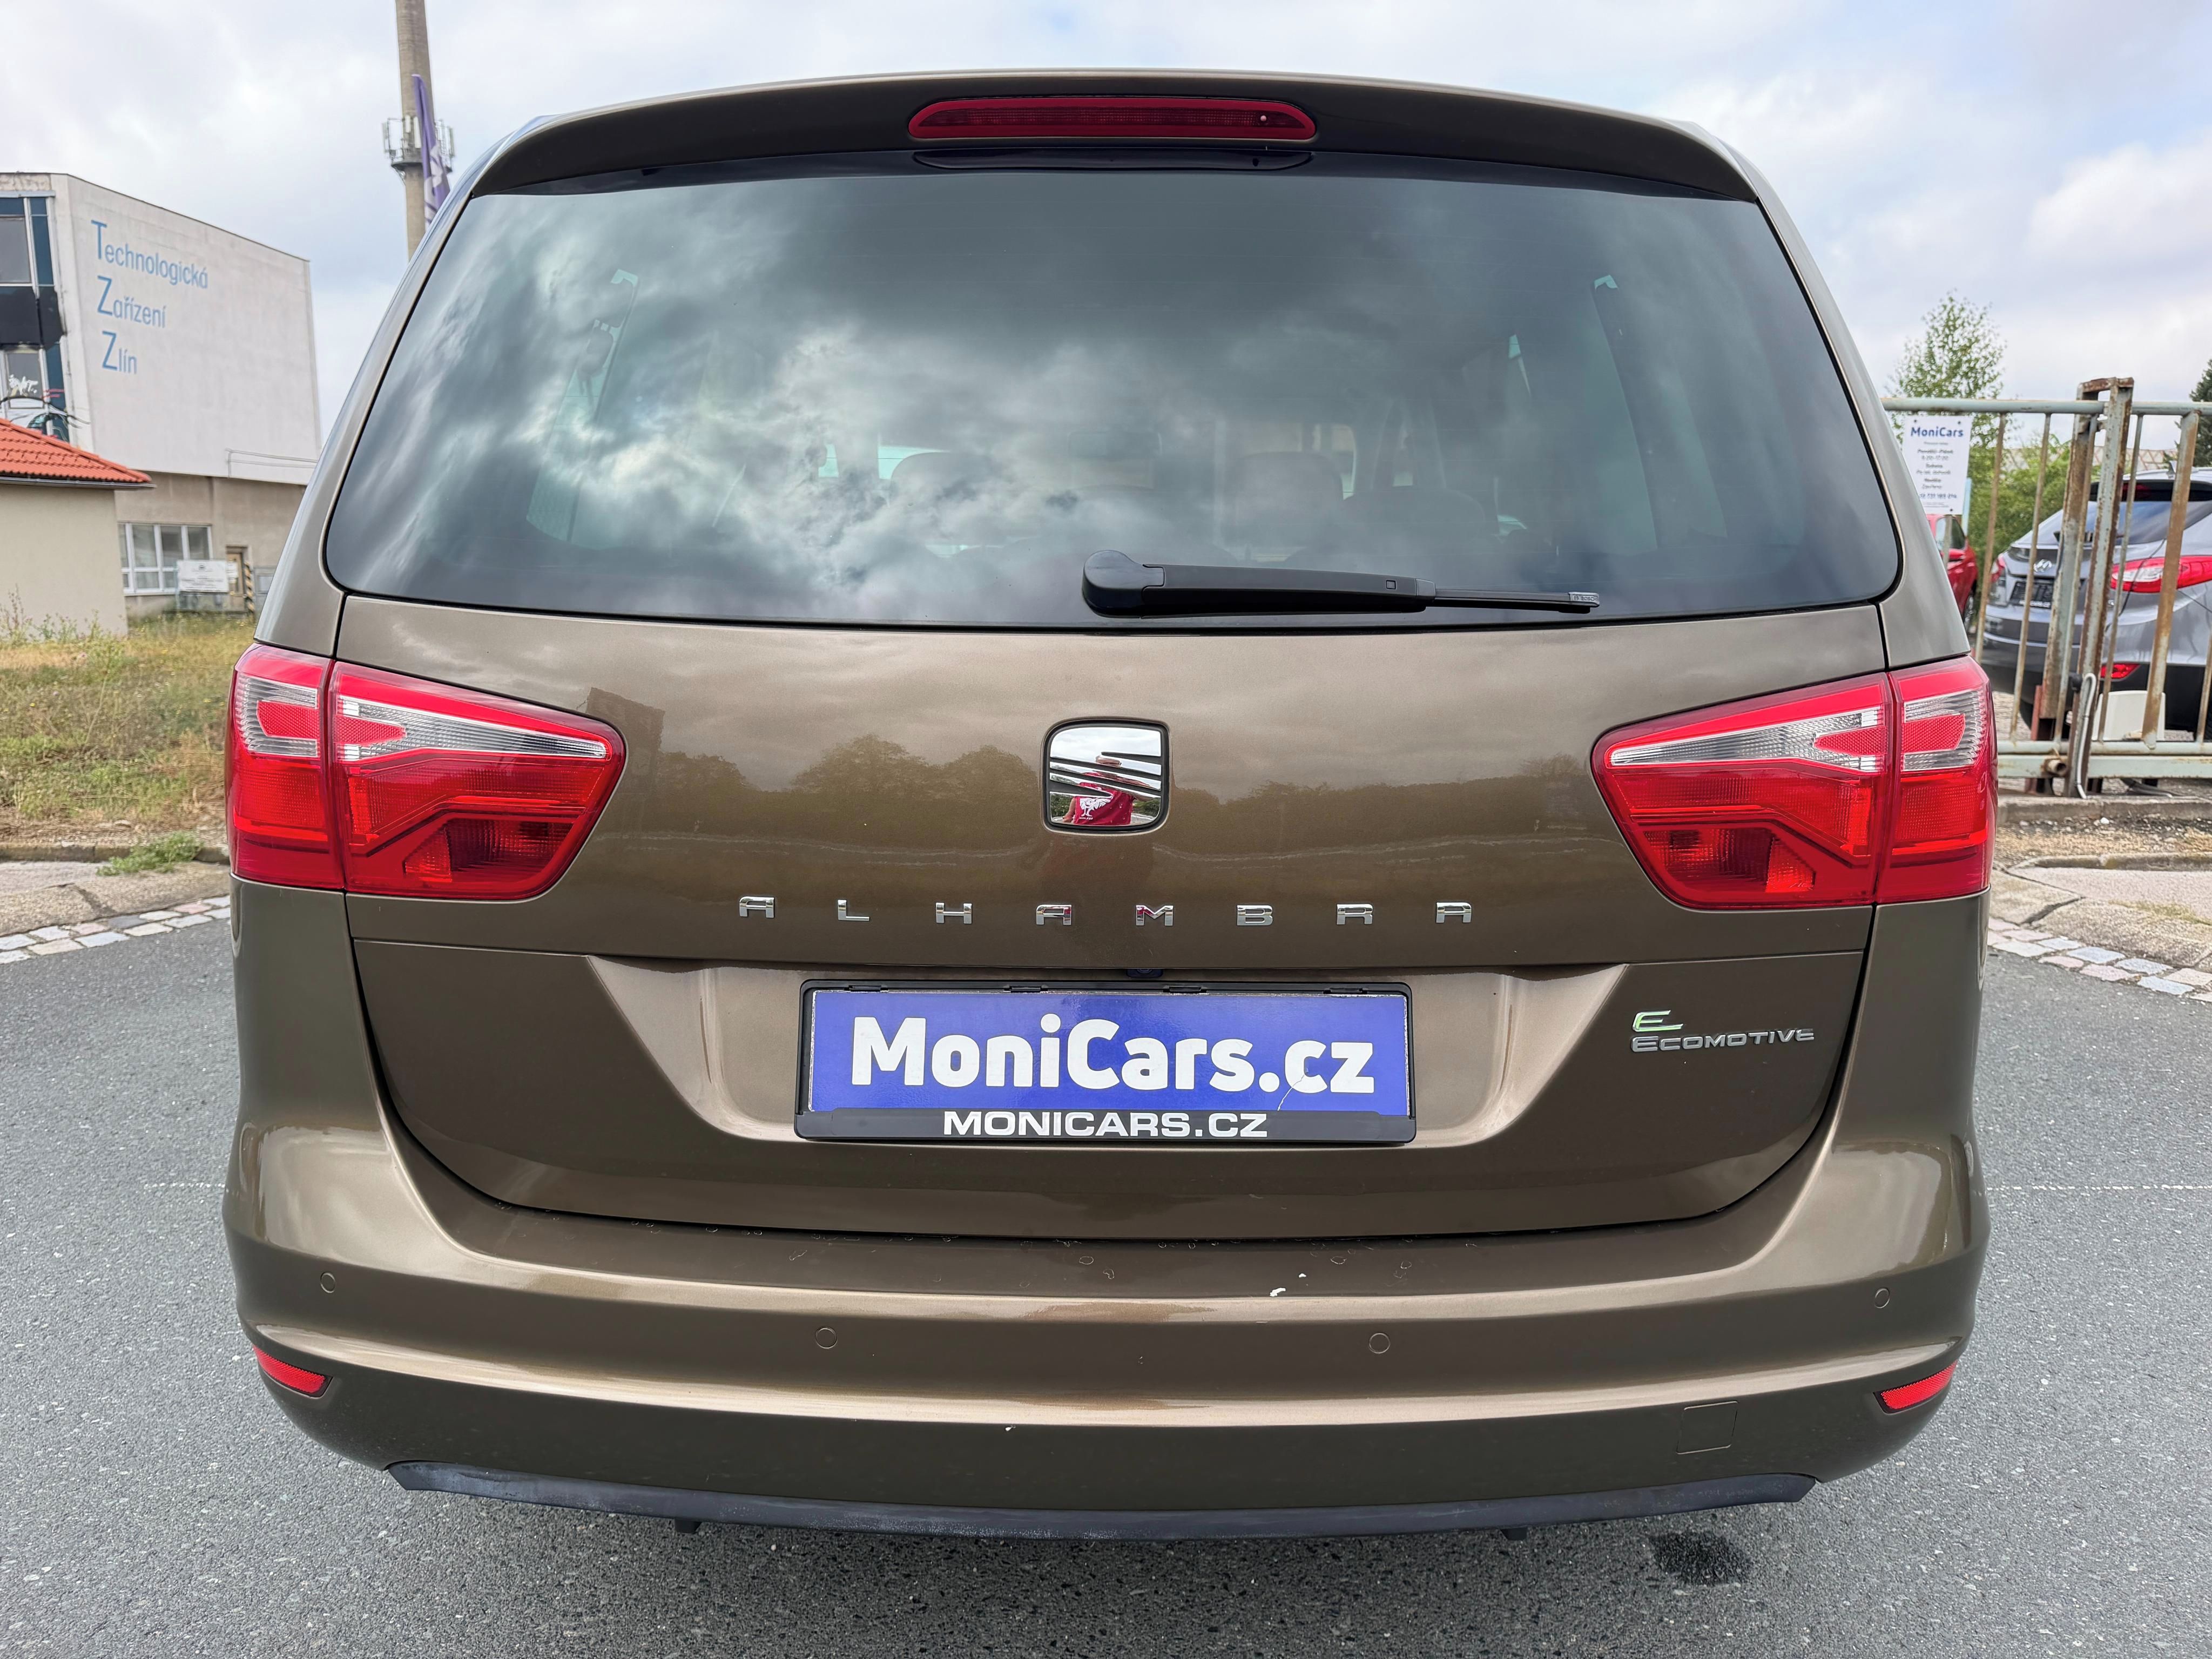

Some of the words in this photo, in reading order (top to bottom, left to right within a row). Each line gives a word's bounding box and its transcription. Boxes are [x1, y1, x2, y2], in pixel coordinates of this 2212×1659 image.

[91, 220, 208, 289] Technologická
[97, 275, 166, 328] Zařízení
[102, 331, 137, 374] Zlín
[1911, 427, 1964, 437] MoniCars
[739, 896, 1472, 927] ALHAMBRA
[851, 1013, 1375, 1094] MoniCars.cz
[1631, 1029, 1814, 1053] ECOMOTIVE
[943, 1110, 1268, 1138] MONICARS.CZ
